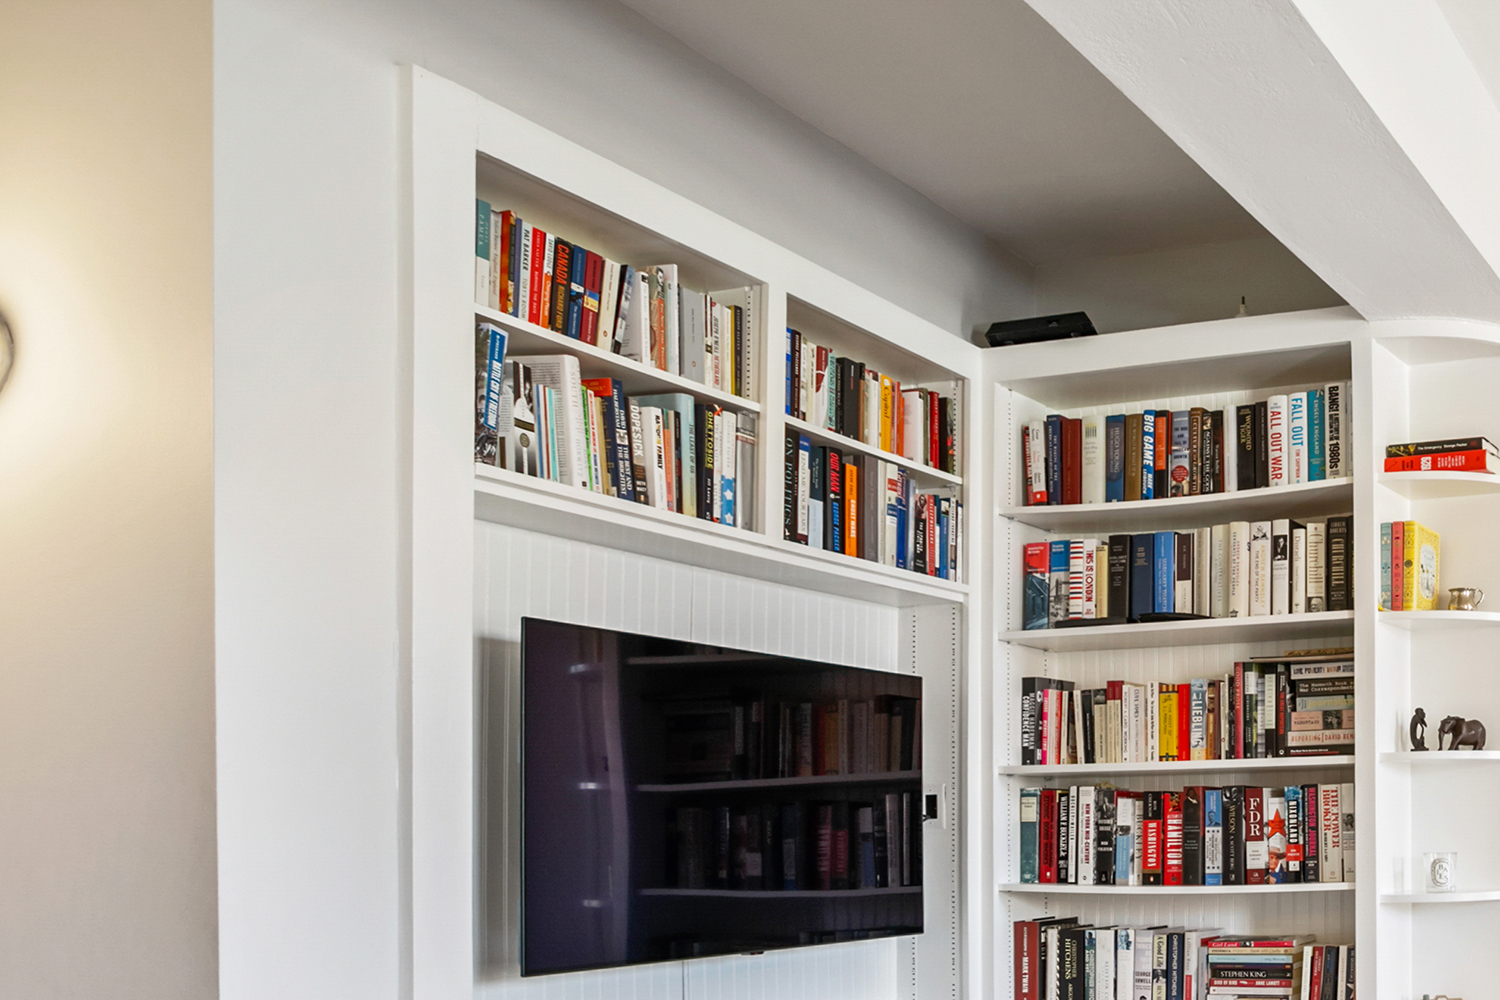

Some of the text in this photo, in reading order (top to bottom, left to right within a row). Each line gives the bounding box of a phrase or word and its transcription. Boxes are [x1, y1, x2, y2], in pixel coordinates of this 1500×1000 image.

[555, 244, 569, 329] CANADA RICHARD FORD
[613, 389, 621, 428] HALBERSTAM
[1291, 398, 1303, 423] FALL
[1328, 386, 1339, 413] BANG!
[630, 405, 644, 457] DOPESICK
[1143, 414, 1154, 467] BIG GAME
[1270, 411, 1283, 481] ALL OUT WAR
[1291, 426, 1304, 446] OUT
[830, 452, 840, 493] OUR MAN
[1329, 441, 1340, 469] 1980s
[618, 460, 627, 495] BRIGHTEST
[785, 438, 793, 525] ON POLITICS
[1085, 550, 1094, 573] THIS IS
[1309, 533, 1324, 584] Churchill
[1331, 538, 1344, 587] CHURCHILL
[1022, 695, 1030, 747] CONFIDENCE MAN
[1291, 734, 1321, 742] REPORTING
[1060, 795, 1068, 821] WILLIAM
[1249, 797, 1261, 837] FDR
[1288, 800, 1298, 843] NIXONLAND
[1308, 787, 1317, 857] WASHINGTON JOURNAL
[1322, 789, 1331, 831] BROKER
[1330, 786, 1340, 848] THE POWER
[1135, 814, 1143, 860] BUCKLEY
[1147, 822, 1157, 867] WASHINGTON
[1167, 819, 1183, 865] HAMILTON
[1220, 970, 1249, 978] STEPHEN
